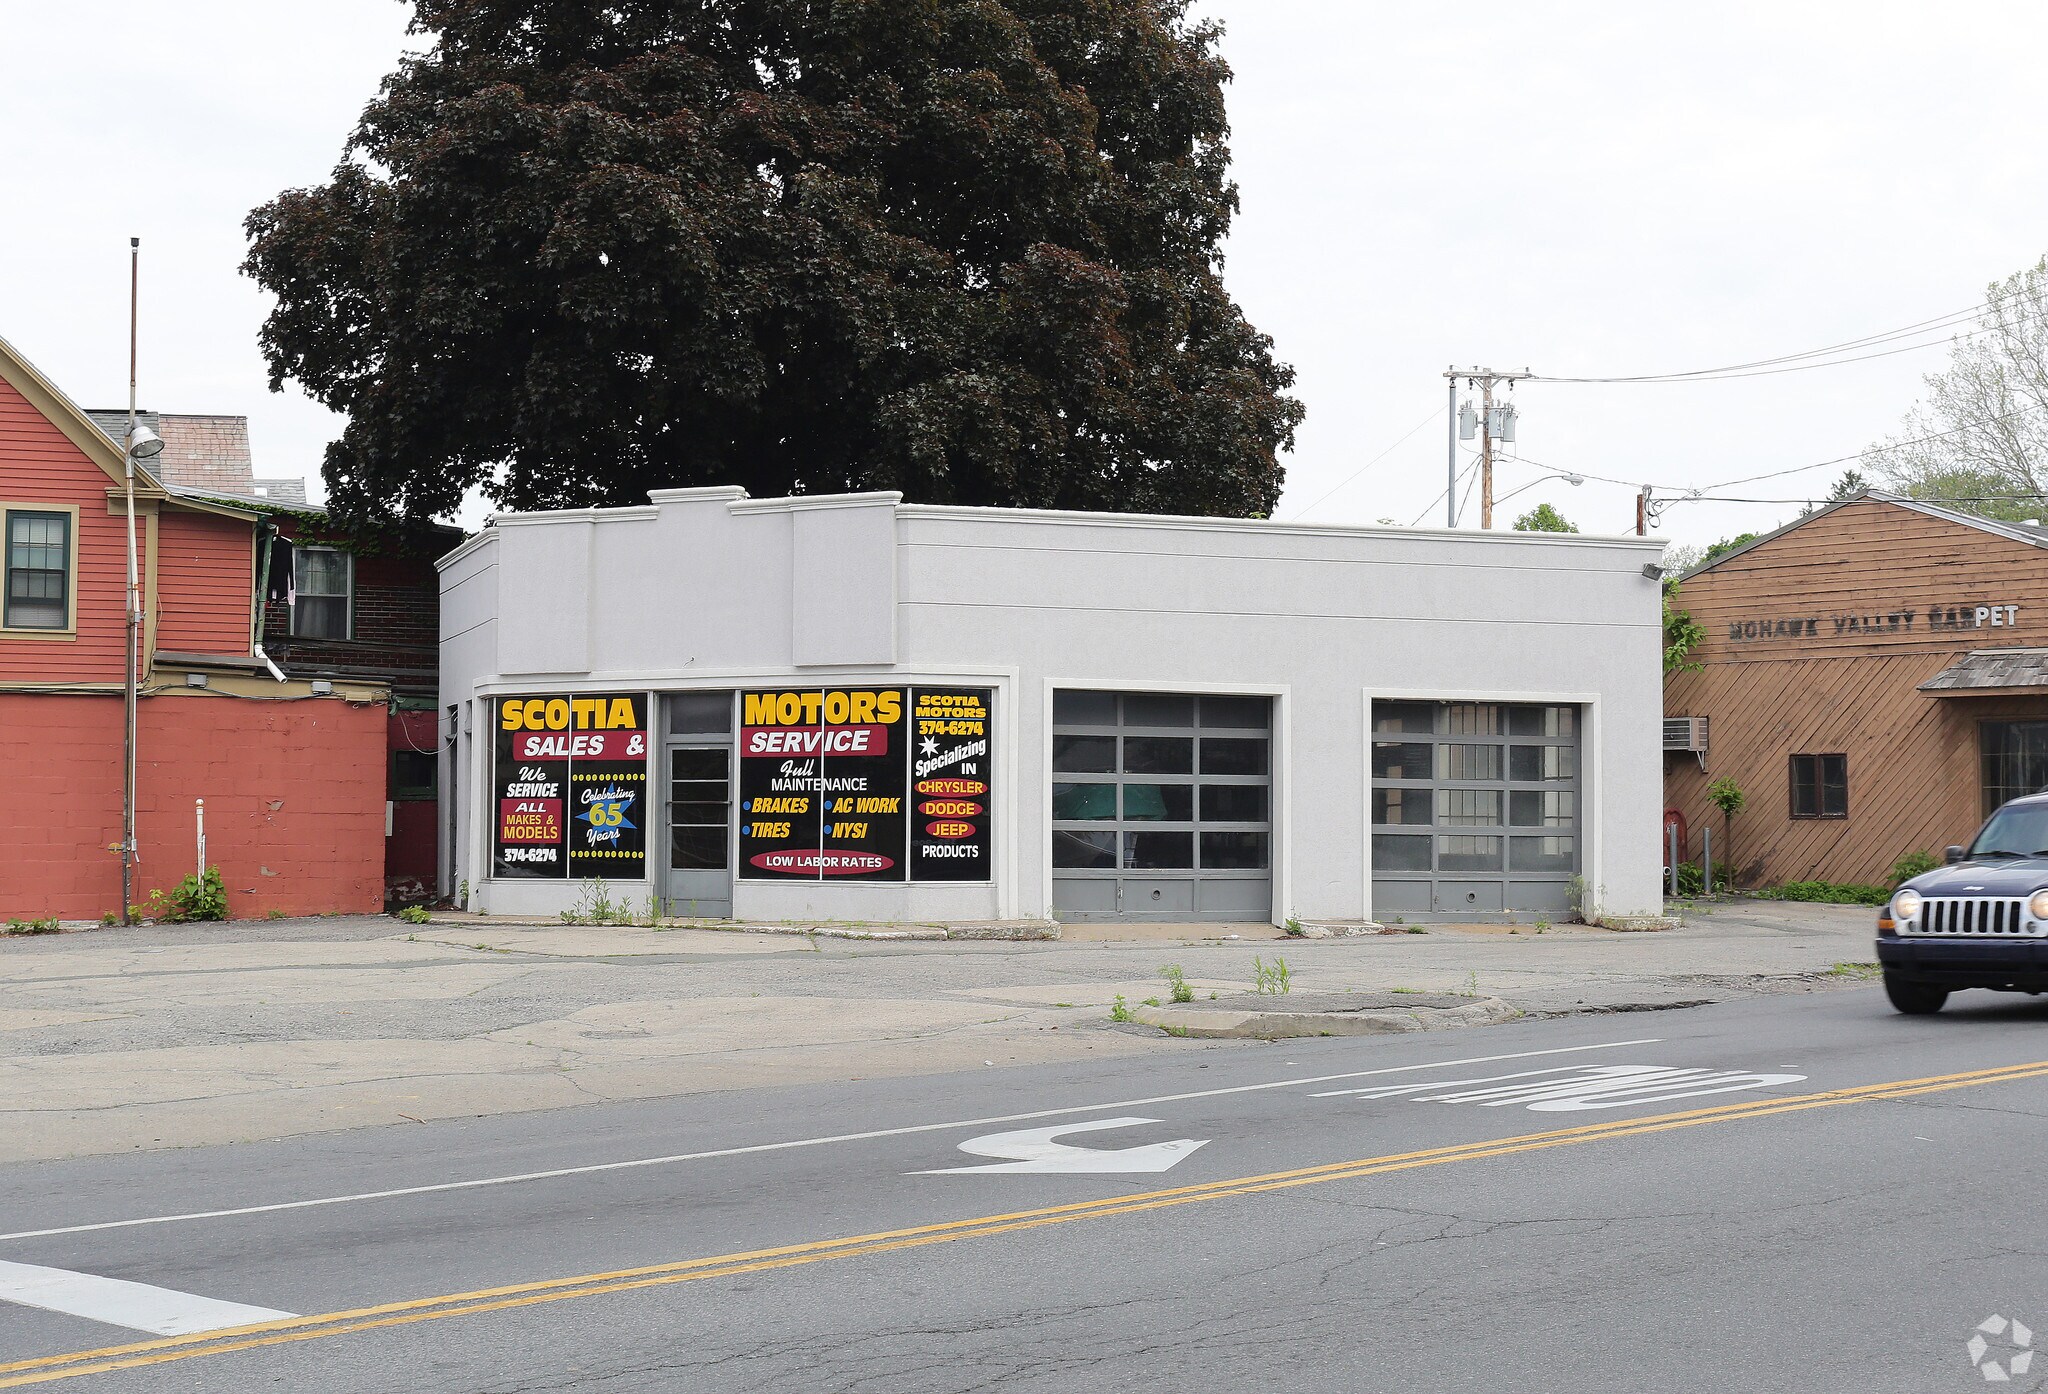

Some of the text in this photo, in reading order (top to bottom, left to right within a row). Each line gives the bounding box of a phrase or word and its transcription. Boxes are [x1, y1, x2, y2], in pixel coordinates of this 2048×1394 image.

[744, 691, 901, 725] MOTORS
[919, 695, 980, 707] SCOTIA
[502, 698, 637, 730] SCOTIA
[915, 706, 986, 718] MOTORS
[919, 720, 984, 736] 374-6274
[524, 734, 645, 756] SALES &
[750, 729, 871, 753] SERVICE
[915, 739, 986, 777] Specializing
[518, 766, 547, 781] We
[780, 758, 814, 777] Full
[961, 763, 977, 775] IN
[506, 782, 559, 798] SERVICE
[771, 777, 868, 792] MAINTENANCE
[918, 781, 983, 794] CHRYSLER
[580, 786, 636, 804] Celebrating
[514, 802, 547, 813] ALL
[751, 797, 809, 814] BRAKES
[832, 797, 901, 814] AC WORK
[925, 802, 975, 815] DODGE
[506, 814, 554, 824] MAKES &
[589, 803, 623, 826] 65
[503, 826, 558, 839] MODELS
[586, 828, 621, 847] Years
[751, 822, 791, 838] TIRES
[832, 822, 868, 839] NYSI
[932, 823, 969, 836] JEEP
[504, 848, 557, 862] 374-6274
[922, 845, 979, 858] PRODUCTS
[766, 856, 882, 868] LOW LABOR RATES
[1306, 1064, 1808, 1111] ONLY
